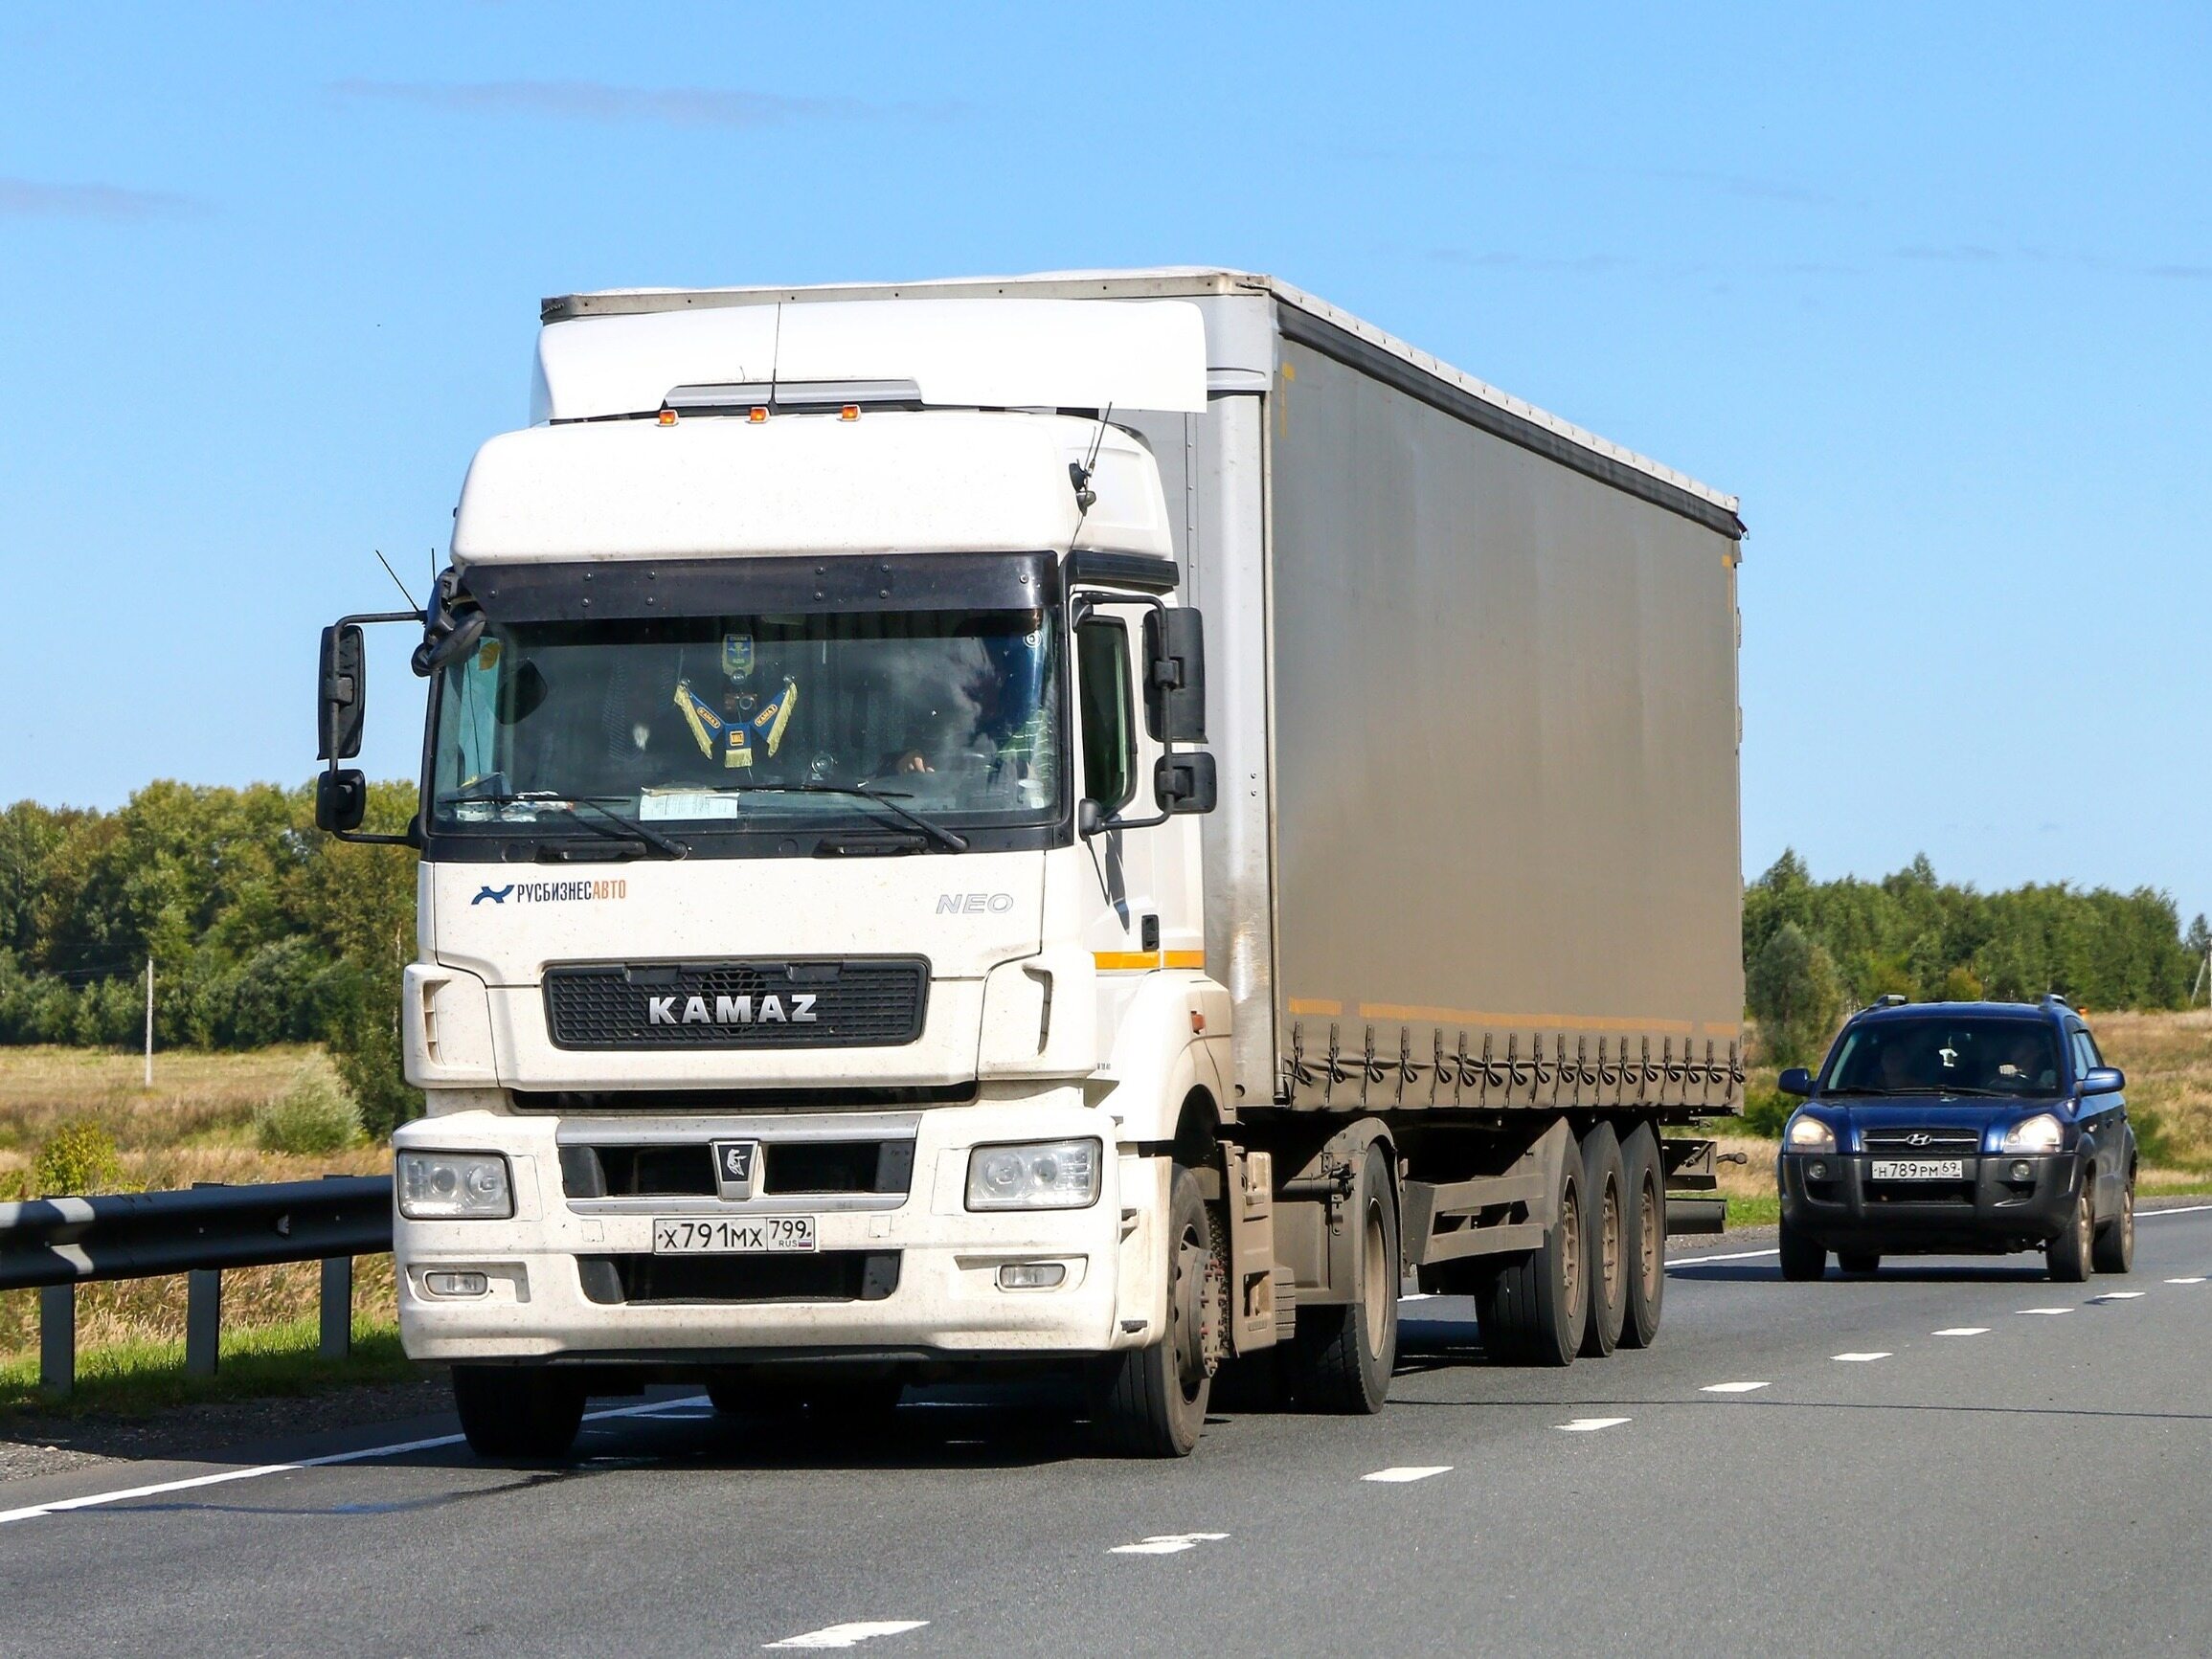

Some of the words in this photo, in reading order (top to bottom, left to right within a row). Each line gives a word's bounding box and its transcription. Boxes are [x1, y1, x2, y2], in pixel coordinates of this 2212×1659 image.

[936, 893, 1014, 914] NEO
[649, 994, 817, 1025] KAMAZ
[769, 1220, 807, 1240] 799
